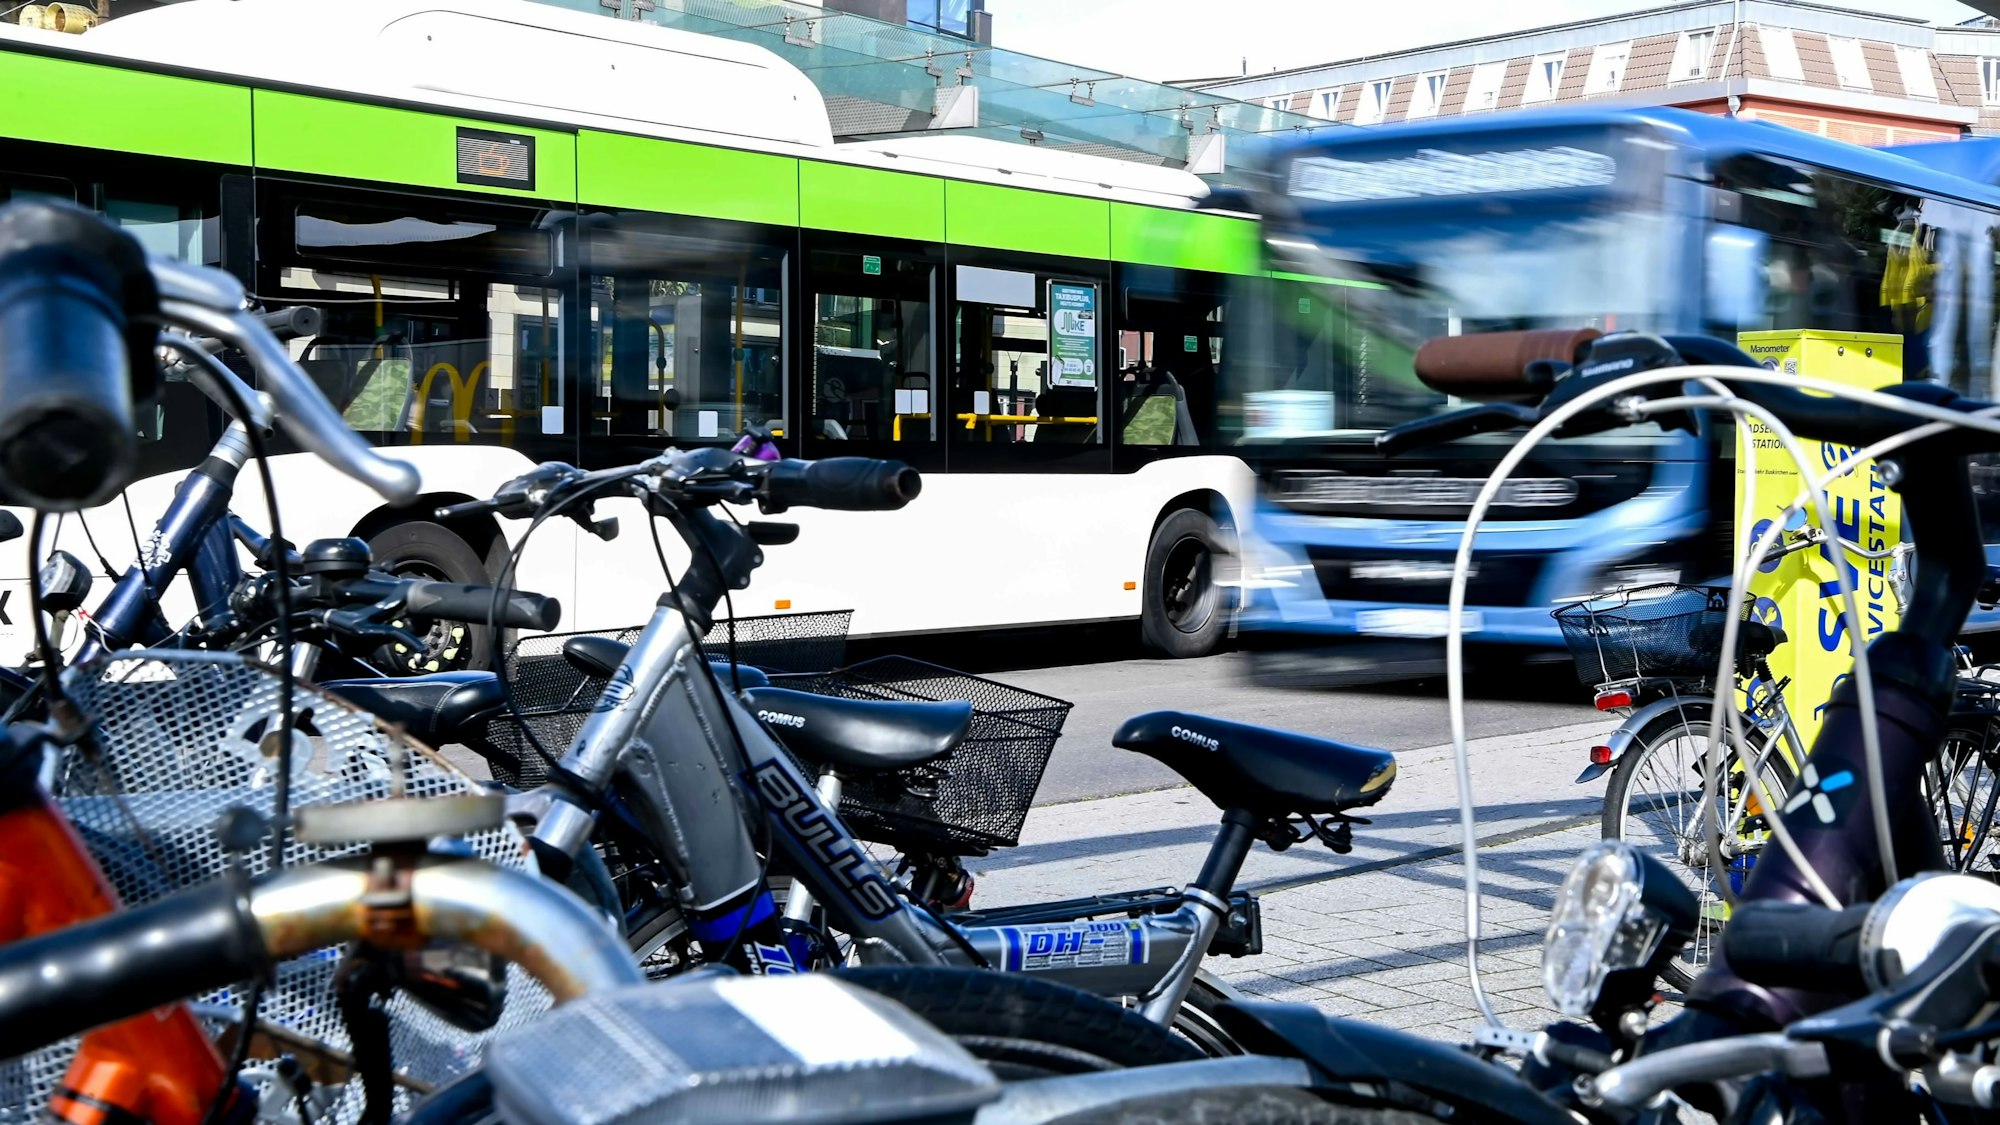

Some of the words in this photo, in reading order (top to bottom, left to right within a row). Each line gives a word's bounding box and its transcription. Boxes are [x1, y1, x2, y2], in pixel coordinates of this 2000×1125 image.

[1750, 345, 1790, 353] Manometer
[1818, 490, 1859, 657] SVE
[758, 710, 805, 728] COMUS
[1171, 726, 1219, 751] COMUS
[755, 764, 896, 915] BULLS
